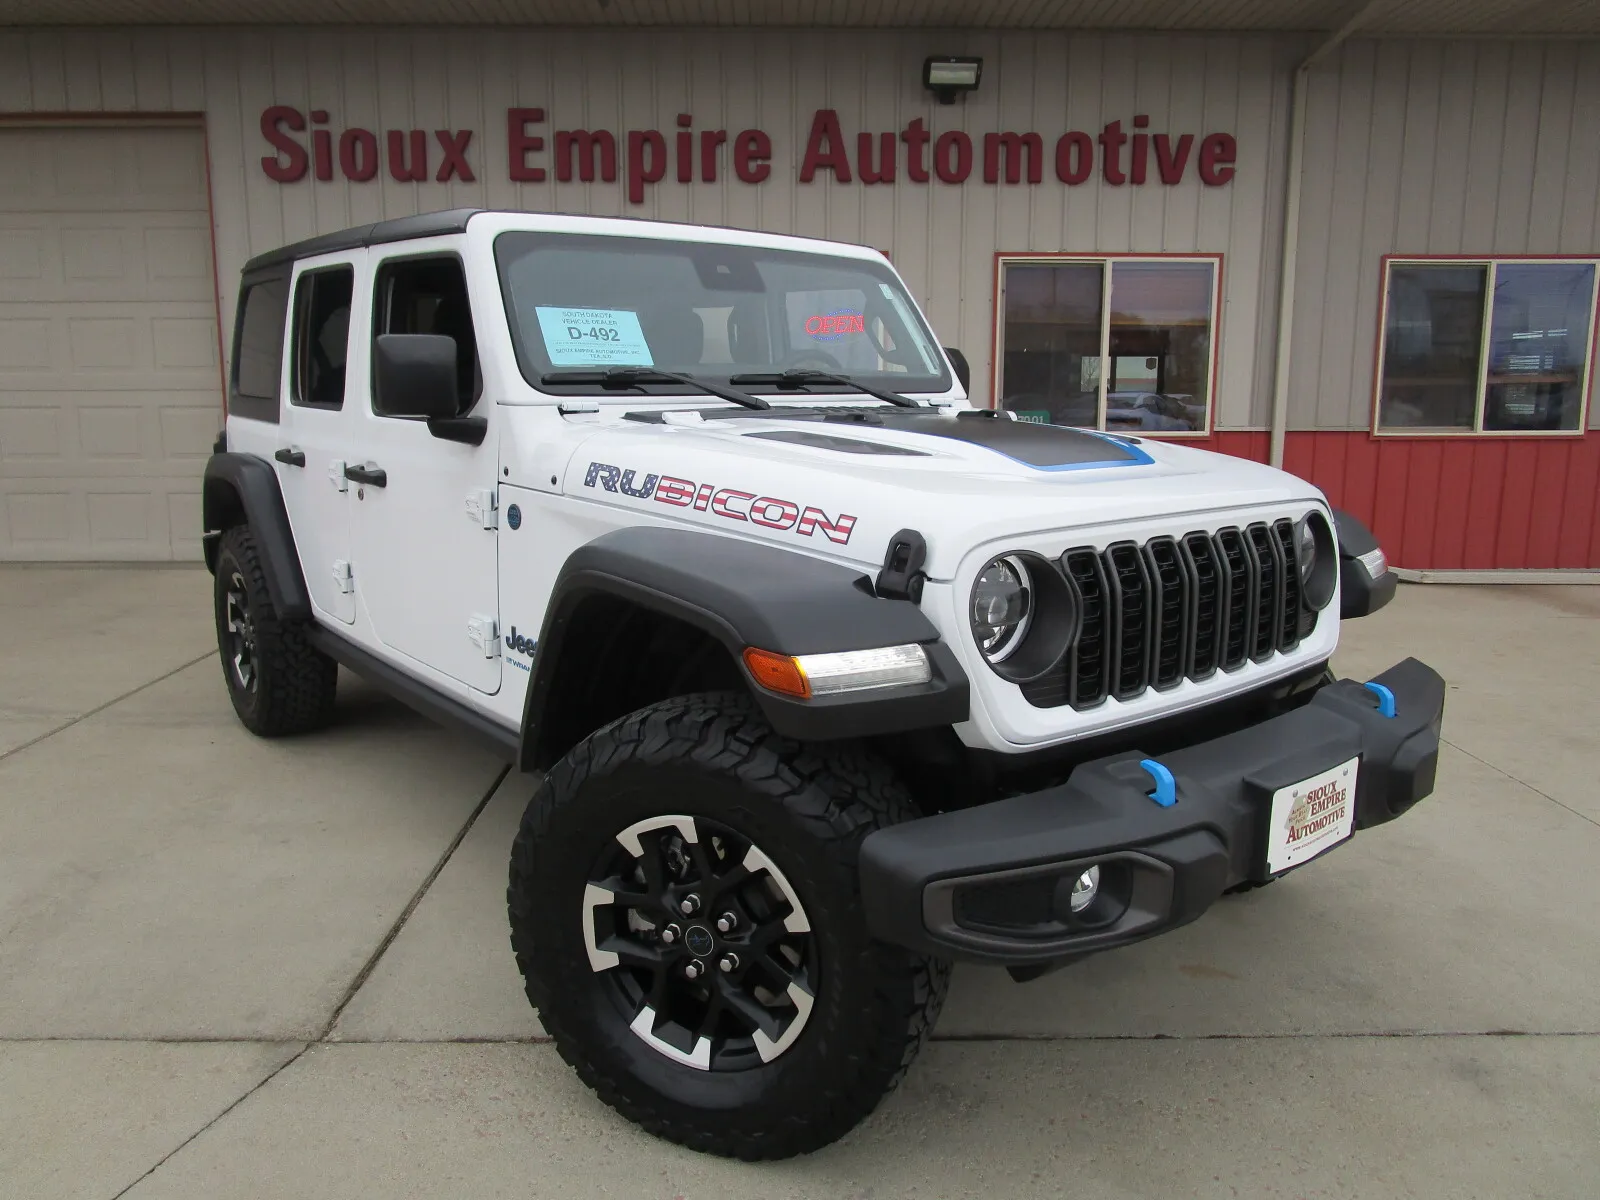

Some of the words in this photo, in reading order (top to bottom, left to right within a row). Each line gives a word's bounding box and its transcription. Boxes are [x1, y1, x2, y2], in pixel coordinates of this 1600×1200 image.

[260, 105, 475, 183] Sioux
[508, 107, 772, 204] Empire
[799, 109, 1238, 186] Automotive
[567, 327, 621, 341] D-492
[805, 315, 865, 335] OPEN
[583, 461, 858, 546] RUBICON
[1307, 781, 1337, 804] SIOUX
[1311, 789, 1346, 816] EMPIRE
[1286, 807, 1344, 844] AUTOMOTIVE
